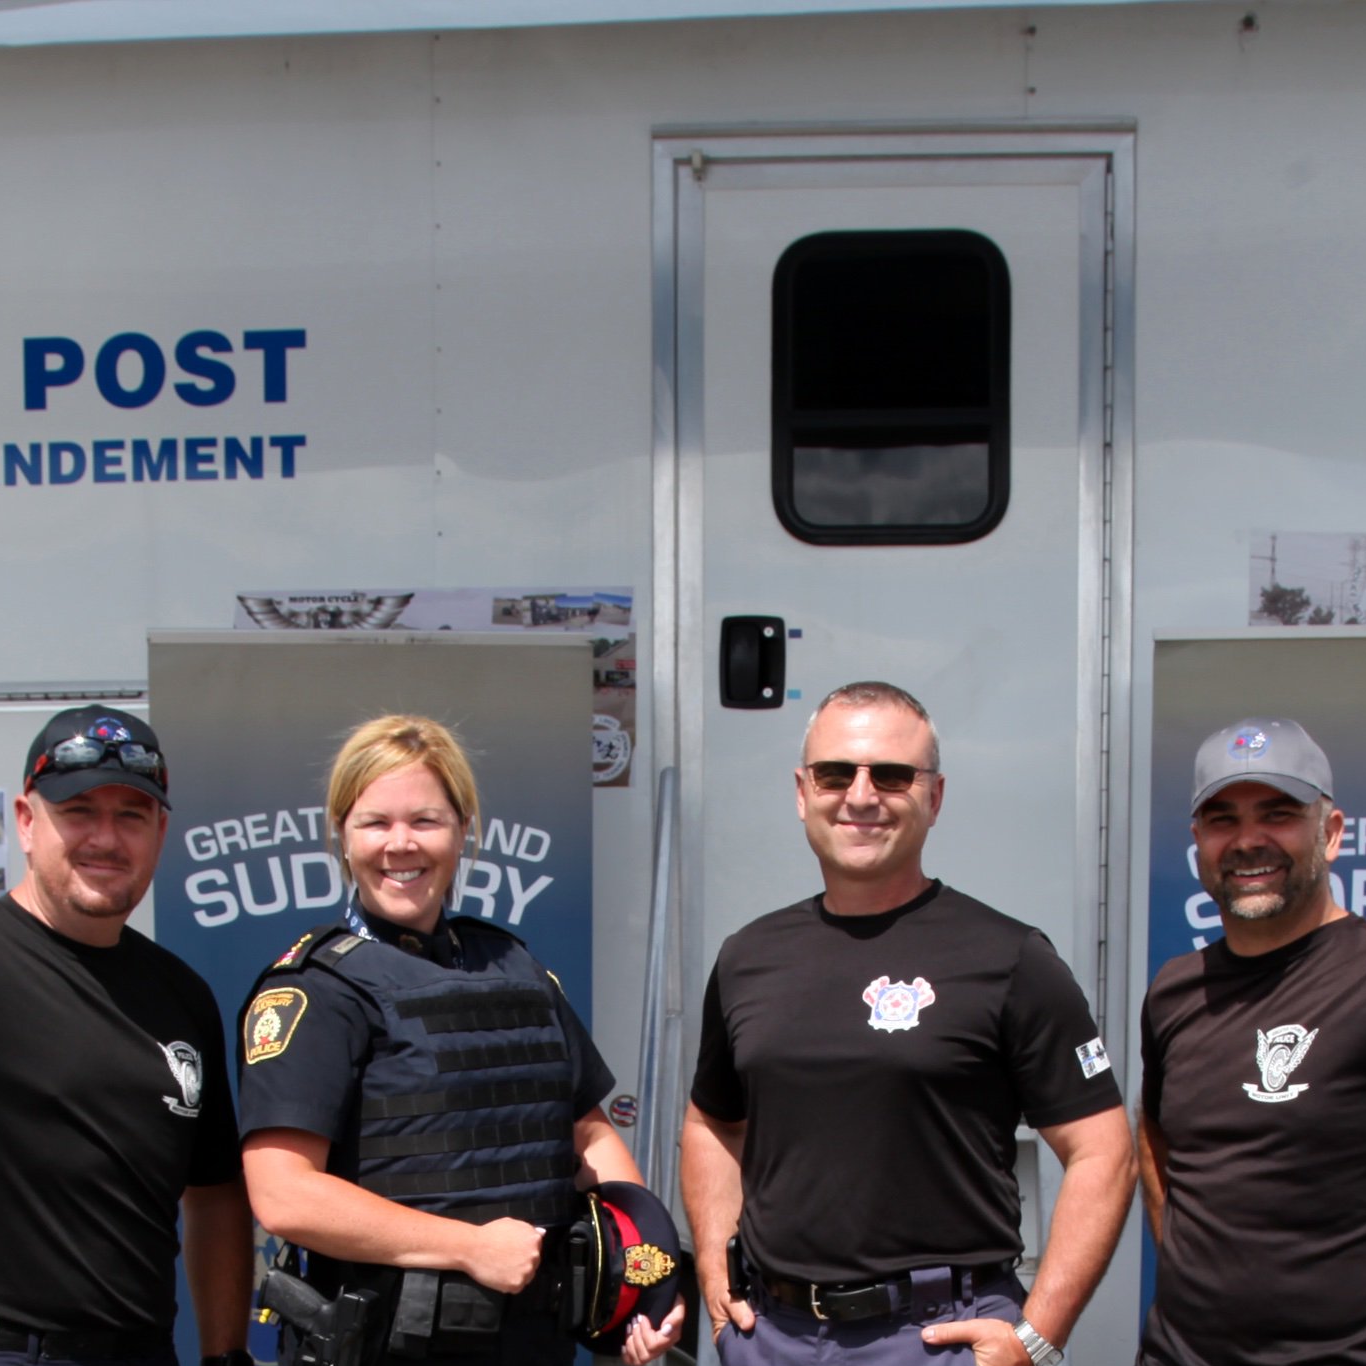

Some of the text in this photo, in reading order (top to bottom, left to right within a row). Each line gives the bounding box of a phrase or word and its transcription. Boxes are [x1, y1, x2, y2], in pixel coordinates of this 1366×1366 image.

[23, 328, 306, 409] POST
[328, 595, 359, 603] CYCLE
[184, 805, 342, 862] GREAT
[184, 850, 555, 929] SUDRY
[249, 1040, 283, 1059] POLICE
